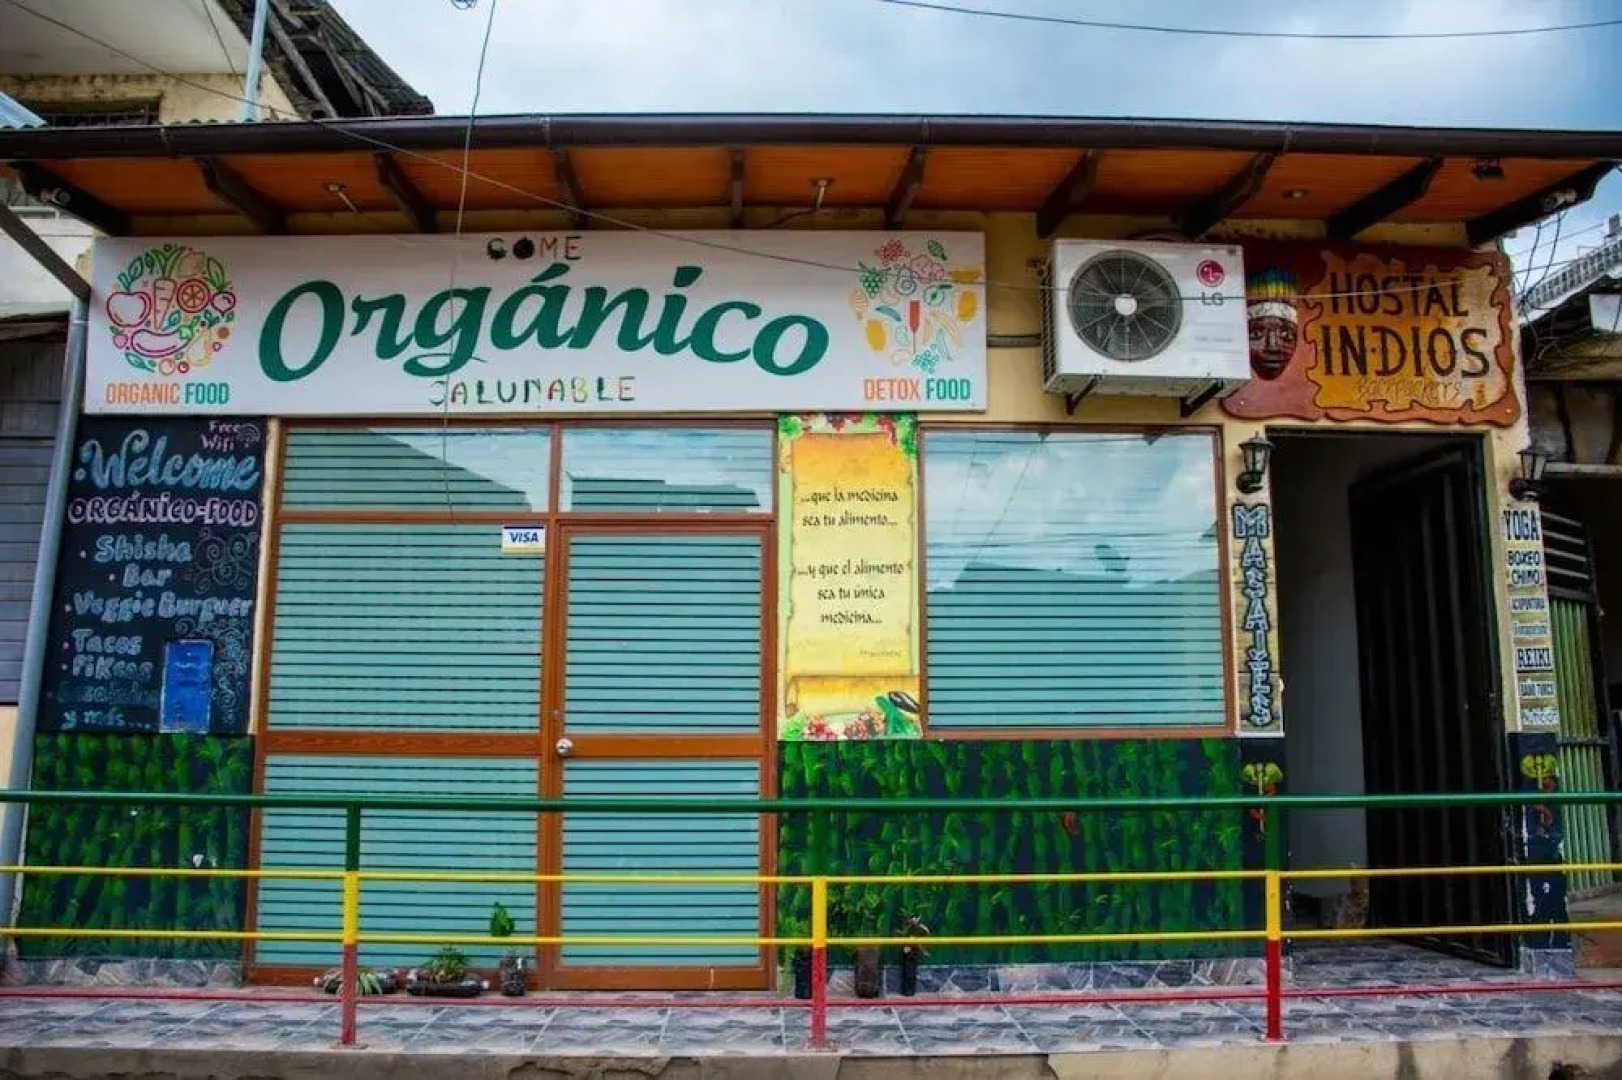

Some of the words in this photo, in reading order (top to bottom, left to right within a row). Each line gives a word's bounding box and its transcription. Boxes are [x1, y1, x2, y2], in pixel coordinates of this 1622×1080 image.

[487, 235, 583, 261] COME
[1201, 290, 1225, 306] LG
[1330, 272, 1468, 316] HOSTAL
[258, 262, 829, 381] Orgánico
[1321, 325, 1490, 378] INDIOS
[106, 383, 180, 405] ORGANIC
[185, 383, 230, 405] FOOD
[864, 378, 919, 400] DETOX
[926, 378, 971, 400] FOOD
[208, 420, 241, 433] Free
[80, 430, 259, 490] Welcome
[834, 487, 844, 502] la
[847, 488, 898, 502] medicina
[802, 516, 820, 527] sea
[823, 516, 835, 527] tu
[1503, 510, 1540, 541] YOGA
[94, 534, 192, 562] Shisha
[509, 531, 539, 543] VISA
[122, 563, 172, 587] Bar
[819, 564, 838, 579] que
[841, 559, 851, 575] el
[854, 558, 904, 575] alimento
[817, 589, 835, 600] sea
[838, 588, 850, 600] tu
[73, 591, 155, 623] Veggie
[72, 629, 142, 655] Tacos
[1518, 648, 1551, 668] REIKI
